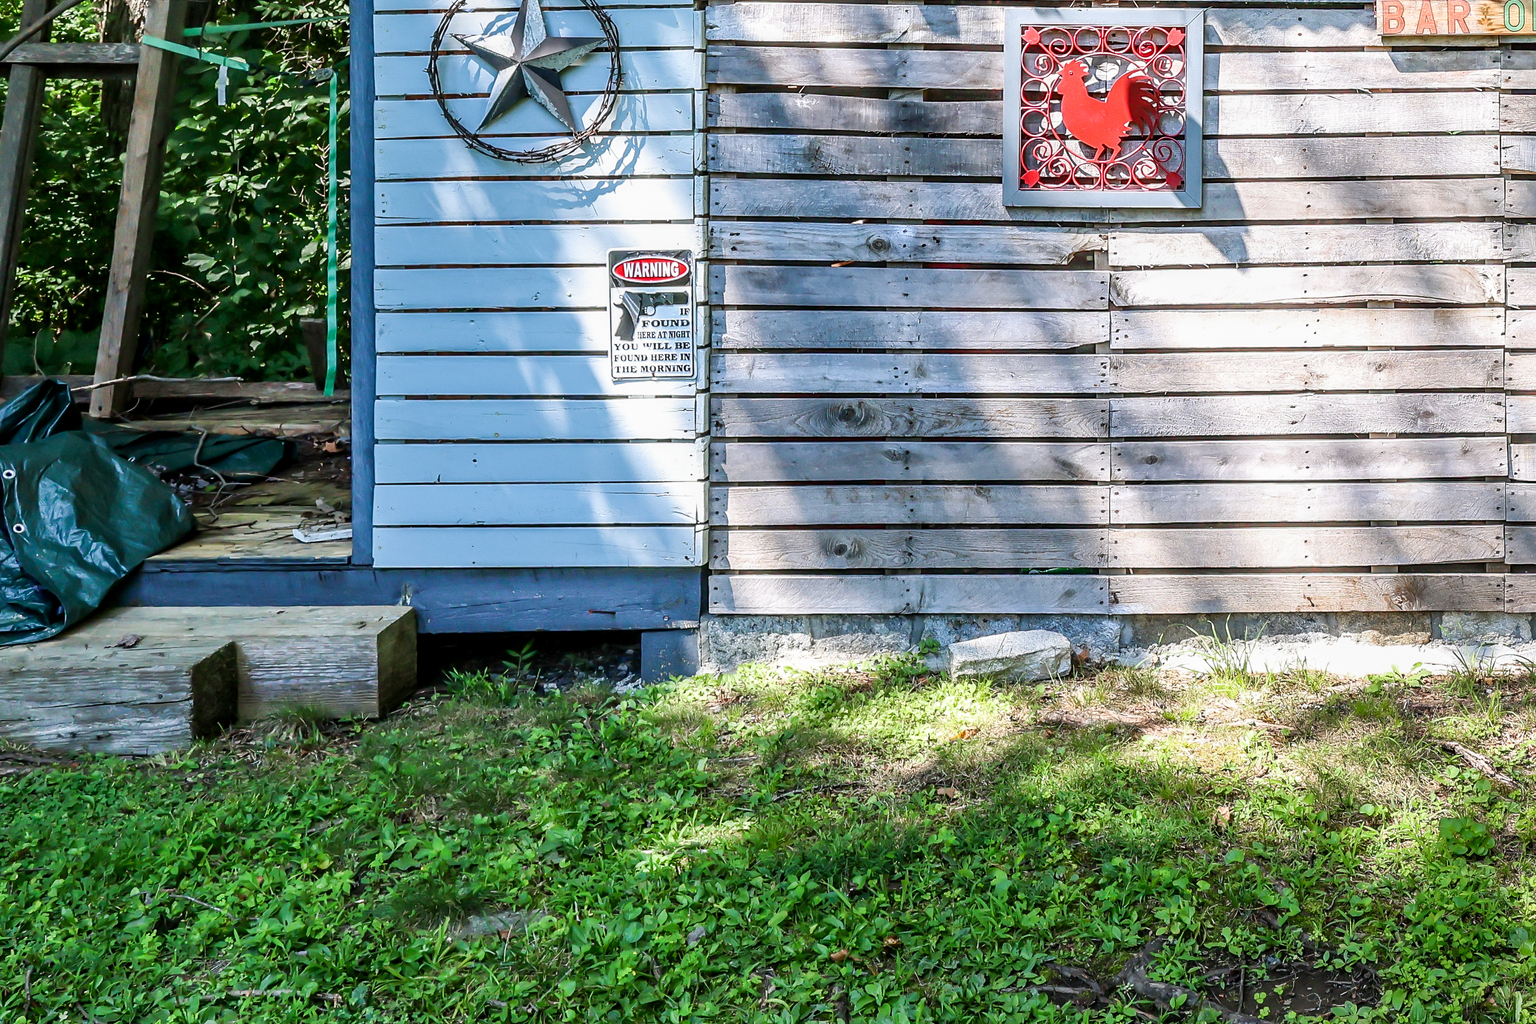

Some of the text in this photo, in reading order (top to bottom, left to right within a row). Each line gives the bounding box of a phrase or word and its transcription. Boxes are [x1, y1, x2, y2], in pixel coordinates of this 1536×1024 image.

[623, 261, 680, 278] WARNING
[680, 307, 691, 316] IF
[641, 319, 691, 328] FOUND
[637, 330, 691, 340] HERE AT NIGHT
[614, 341, 691, 351] YOU WILL BE
[614, 352, 691, 363] FOUND HERE IN
[614, 364, 692, 374] THE MORNING
